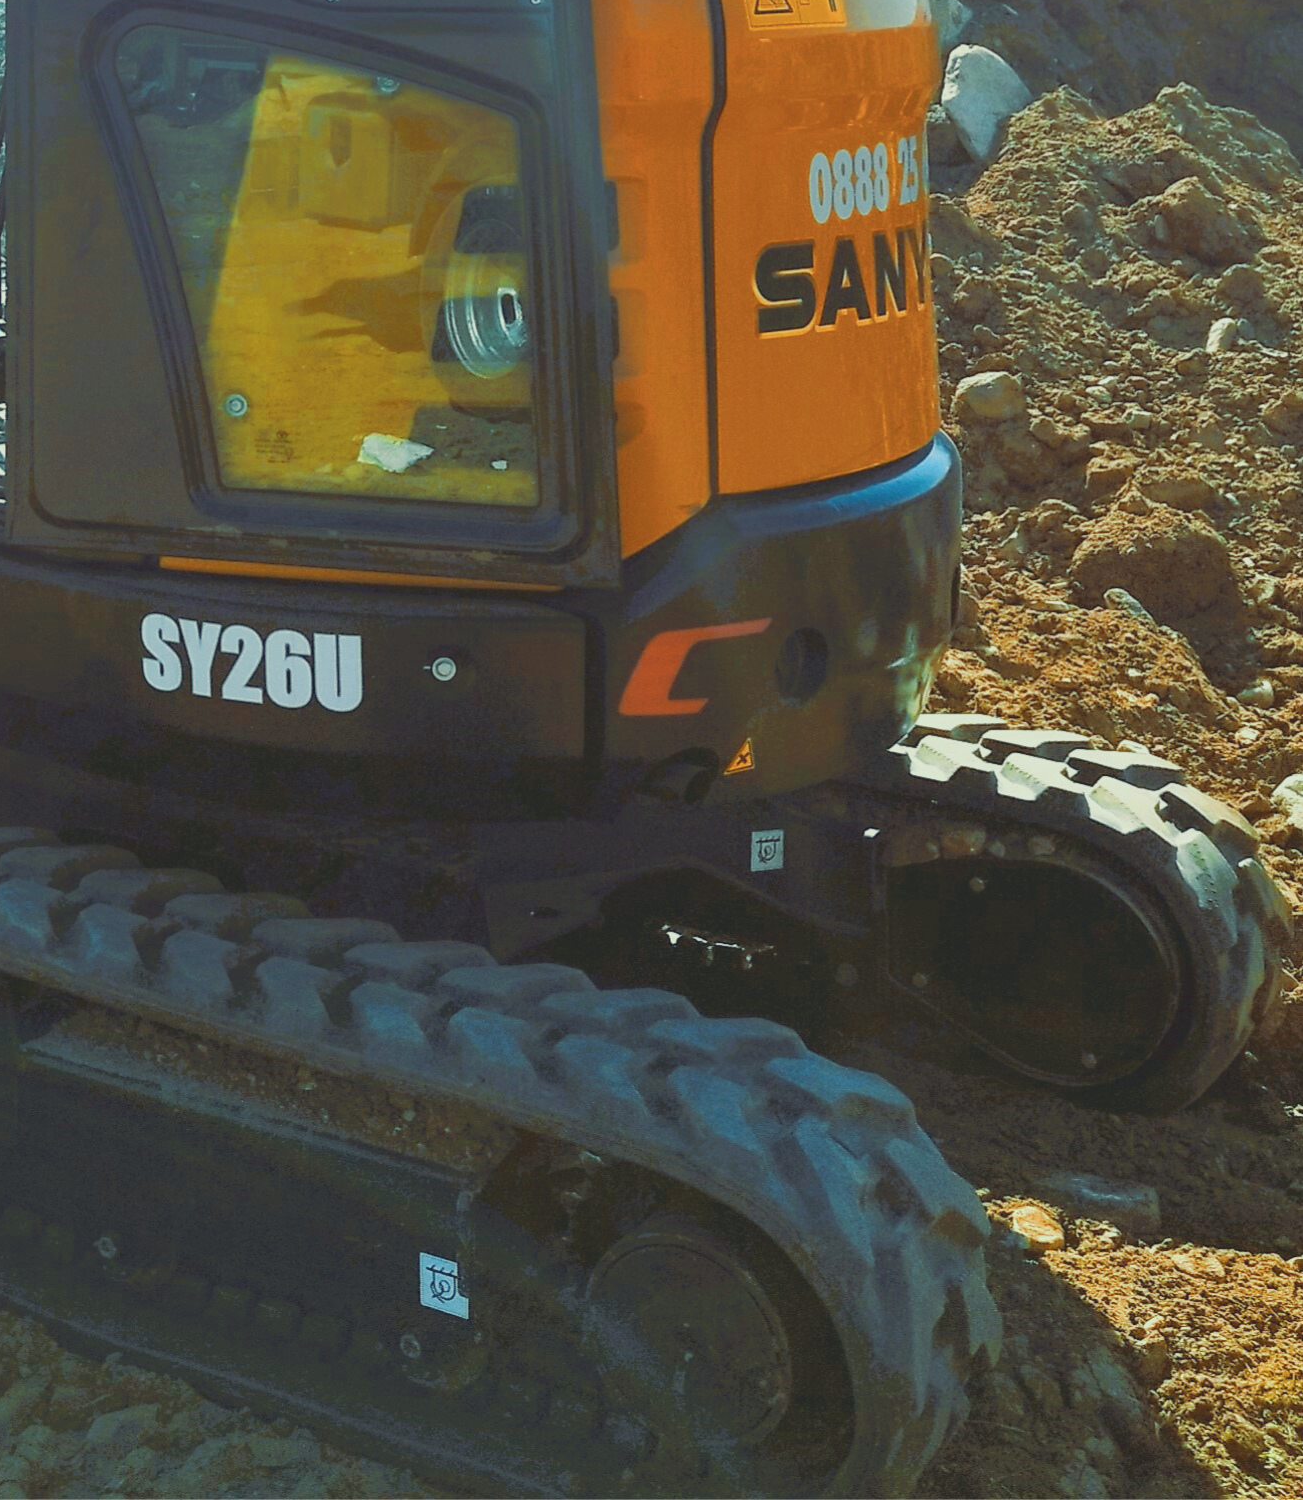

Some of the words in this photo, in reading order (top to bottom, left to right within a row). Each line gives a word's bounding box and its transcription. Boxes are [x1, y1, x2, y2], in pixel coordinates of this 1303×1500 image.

[809, 142, 889, 224] 0888
[898, 135, 919, 206] 25
[755, 222, 928, 334] SANY
[141, 612, 363, 713] SY26U
